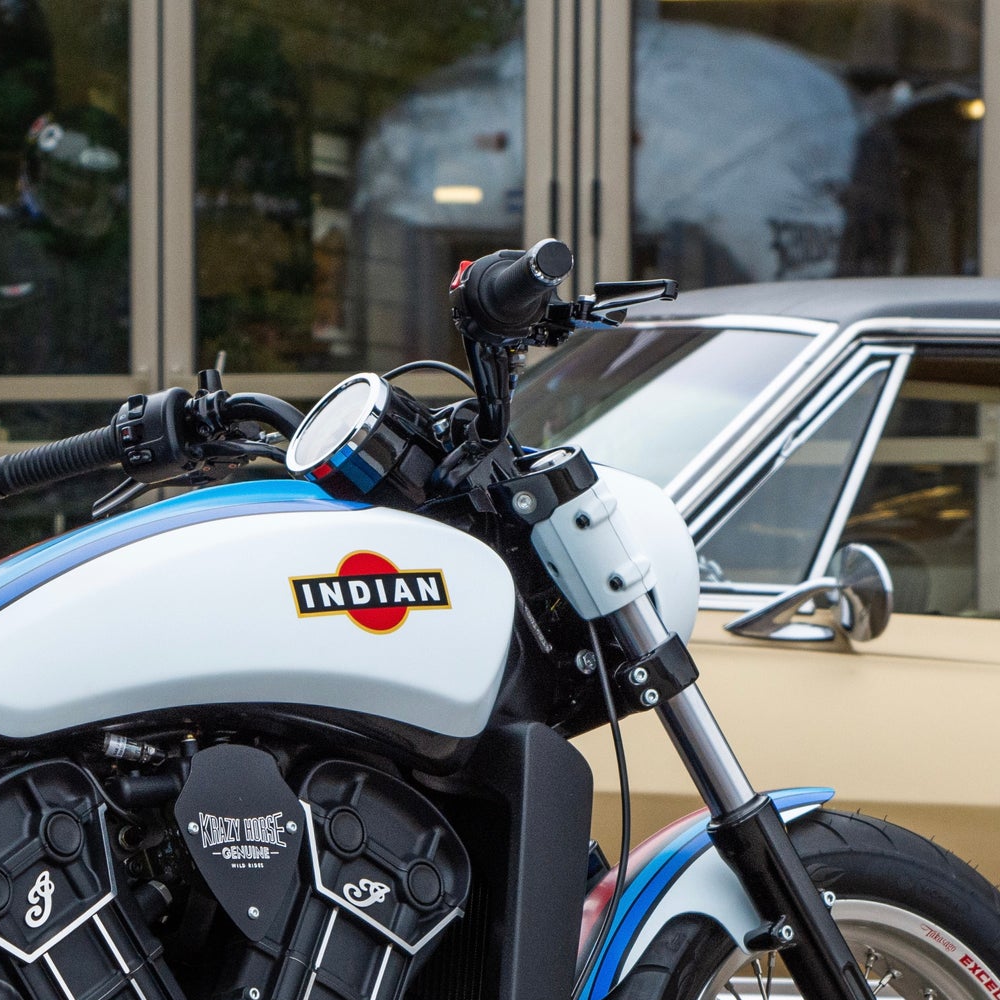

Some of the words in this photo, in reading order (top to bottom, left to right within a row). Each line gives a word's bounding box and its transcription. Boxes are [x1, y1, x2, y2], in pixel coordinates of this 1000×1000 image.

[301, 576, 441, 609] INDIAN
[198, 811, 241, 849] KRAZY
[243, 811, 287, 848] HORSE
[221, 845, 271, 860] GENUINE
[920, 923, 957, 953] Takasago
